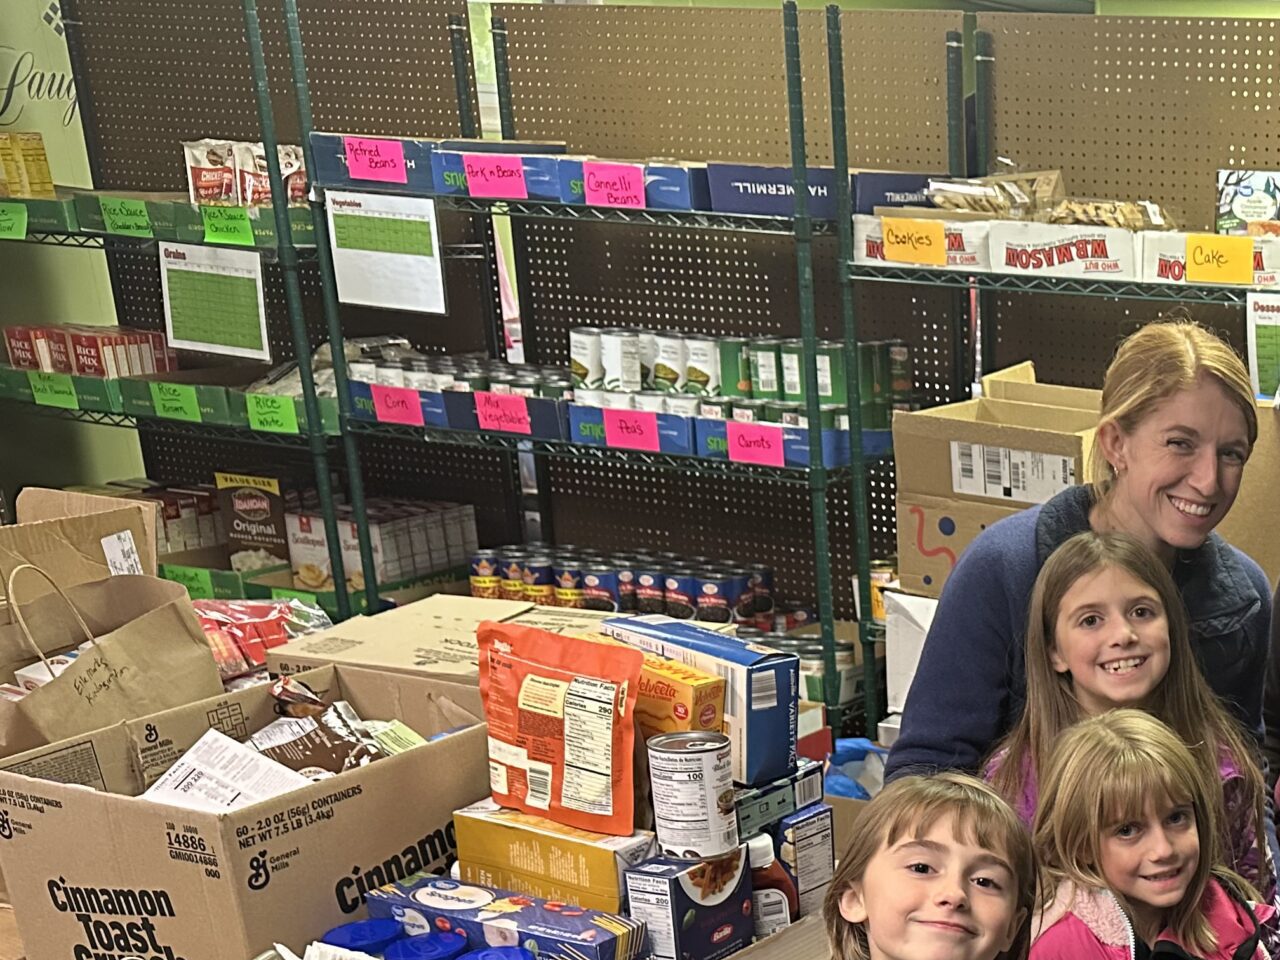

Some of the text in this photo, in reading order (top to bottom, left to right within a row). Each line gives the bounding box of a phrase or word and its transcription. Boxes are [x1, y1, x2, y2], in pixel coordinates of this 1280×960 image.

[347, 141, 380, 162] Refried
[368, 157, 397, 169] Beans
[467, 165, 488, 181] Pork
[496, 165, 522, 179] Beans
[331, 196, 362, 208] Vegetables
[607, 193, 641, 205] Beans
[203, 208, 219, 220] Rice
[224, 210, 246, 220] Sauce
[209, 223, 240, 234] Chicken
[886, 228, 932, 250] Cookies
[164, 248, 187, 260] Grains
[1005, 238, 1109, 269] W.B.MASON
[1193, 245, 1229, 268] Cake
[1084, 260, 1120, 272] WHO BUT
[76, 344, 97, 356] RICE
[79, 354, 98, 367] MIX
[158, 383, 181, 397] Rice
[254, 395, 281, 410] Rice
[383, 394, 408, 410] Corn
[482, 409, 528, 425] Vegetables
[737, 434, 772, 450] Carrots
[222, 475, 250, 486] VALUE
[233, 519, 276, 538] Original
[598, 705, 613, 715] 290
[687, 772, 704, 781] 100
[236, 826, 249, 838] 60
[256, 817, 271, 832] 2.0
[273, 811, 285, 824] OZ
[288, 804, 310, 821] (56g)
[311, 784, 363, 811] CONTAINERS
[238, 806, 334, 850] NET WT 7.5 LB (3.4kg)
[166, 831, 207, 852] 14886
[820, 831, 831, 841] 200
[269, 846, 300, 865] General
[271, 860, 290, 873] Mills
[47, 875, 176, 917] Cinnamon
[655, 897, 670, 905] 200
[75, 912, 165, 954] Toast
